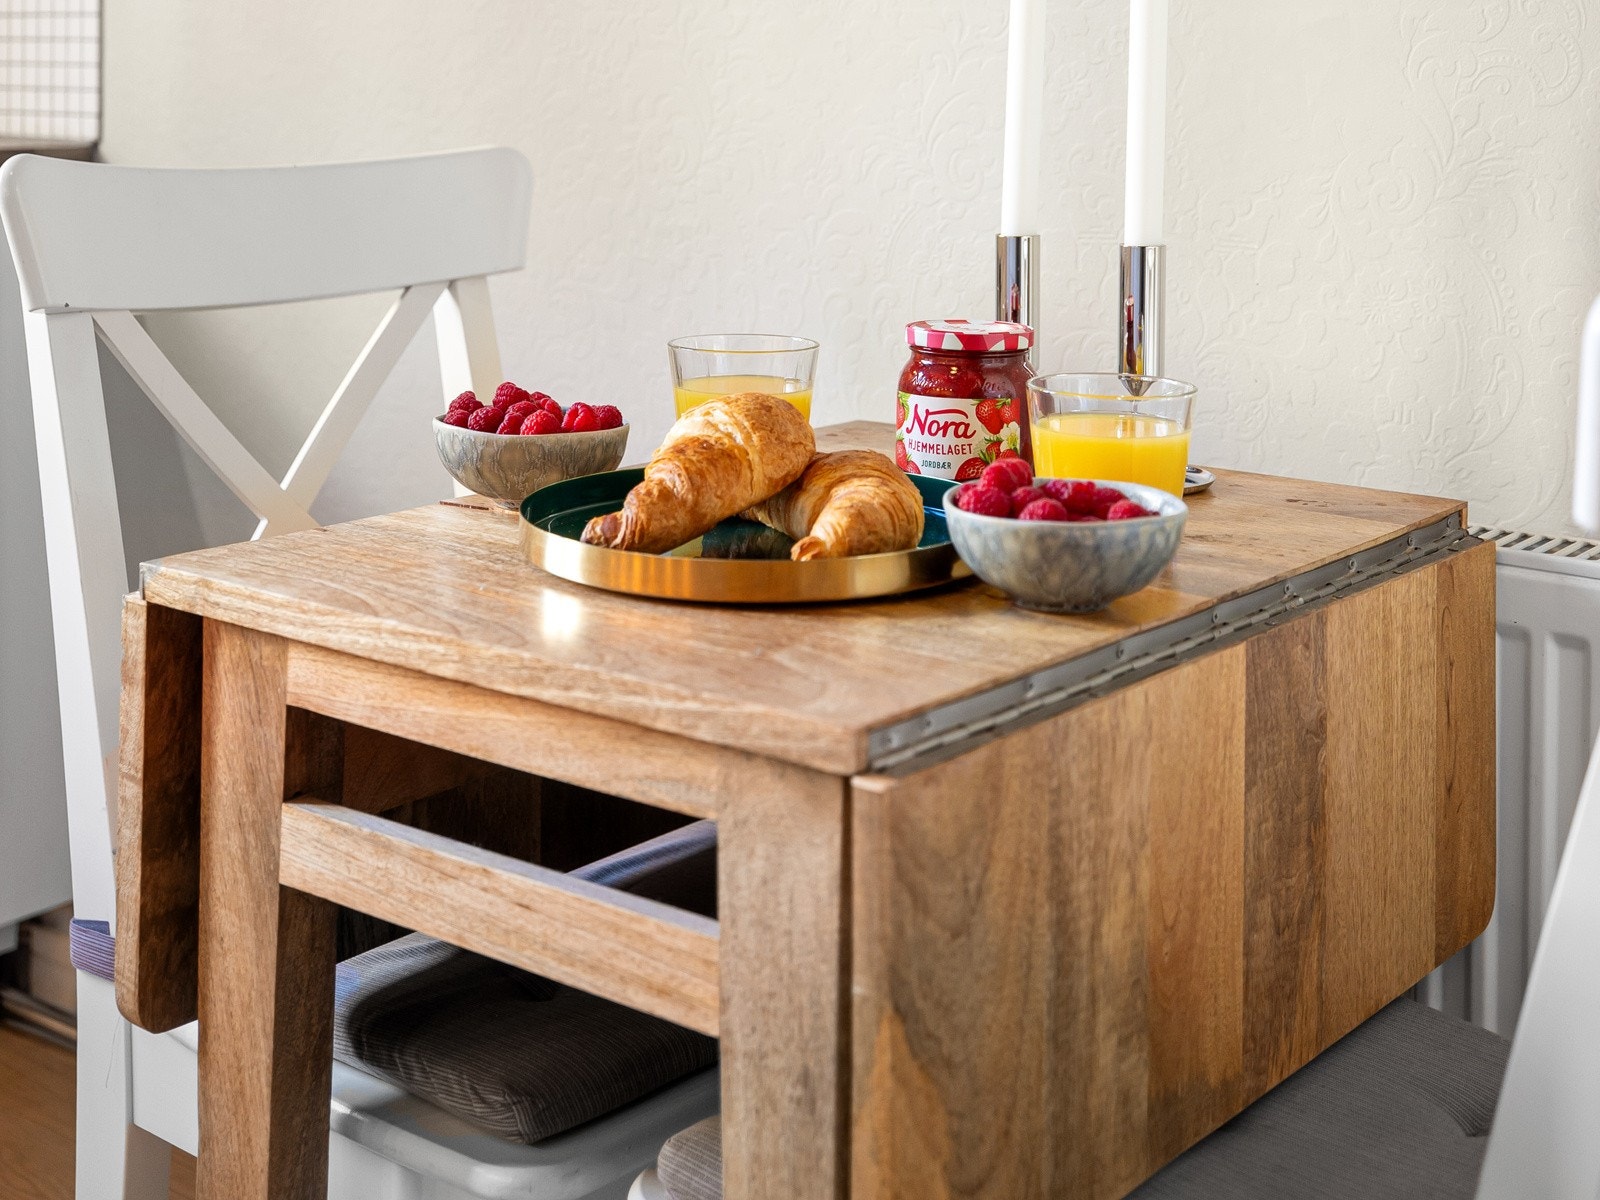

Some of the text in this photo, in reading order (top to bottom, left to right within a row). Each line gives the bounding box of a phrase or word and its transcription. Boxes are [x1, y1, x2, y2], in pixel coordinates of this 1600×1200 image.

[906, 404, 976, 439] Nora
[908, 438, 973, 455] HJEMMELAGET
[921, 460, 952, 469] JORDBÆR
